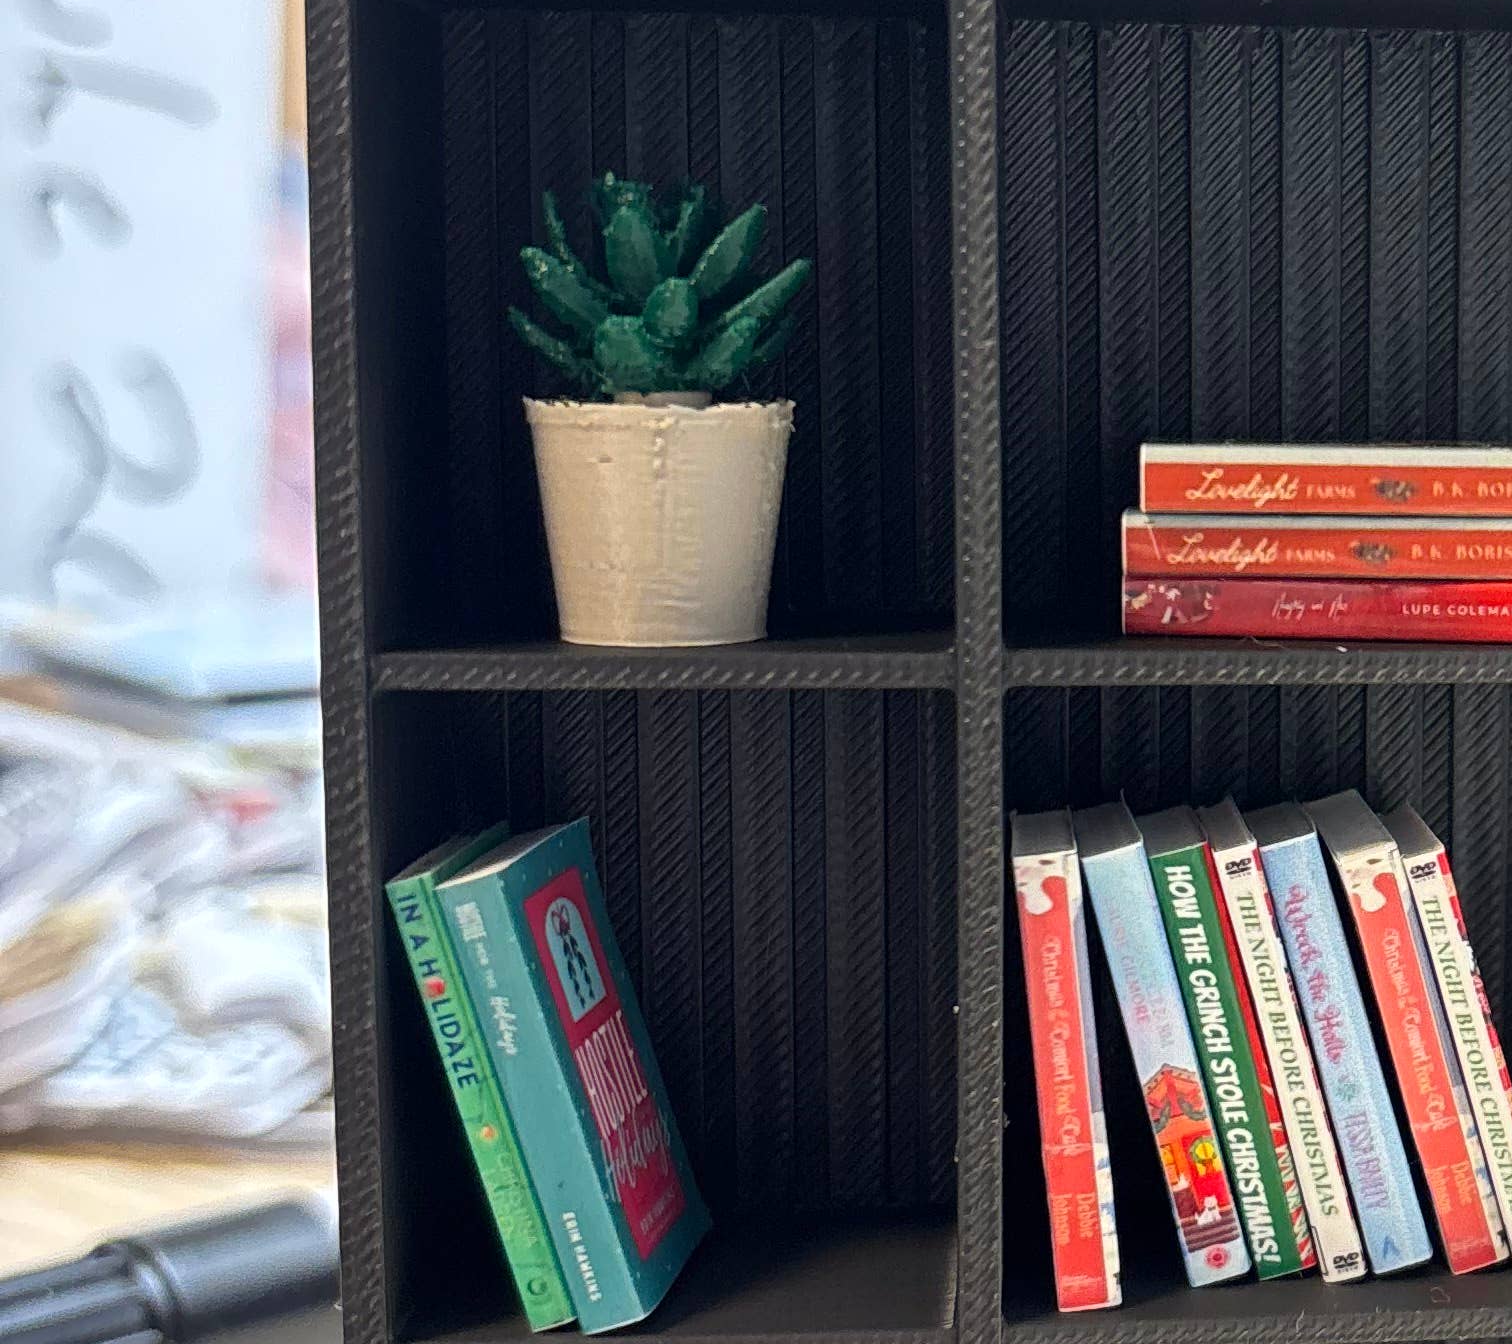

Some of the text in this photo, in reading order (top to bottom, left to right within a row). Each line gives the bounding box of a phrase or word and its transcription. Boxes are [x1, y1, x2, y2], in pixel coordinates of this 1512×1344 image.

[1185, 468, 1299, 508] Lovelight
[1167, 532, 1279, 572] Lovelight
[1401, 604, 1441, 617] LUPE
[398, 893, 422, 922] IN
[410, 931, 432, 950] A
[1422, 894, 1447, 935] THE
[1435, 939, 1467, 1006] NIGHT
[1456, 1012, 1492, 1091] BEFORE
[1167, 864, 1279, 1265] HOW THE GRINCH STOLE CHRISTMAS!
[1235, 891, 1261, 930] THE
[1249, 934, 1281, 1002] NIGHT
[1269, 1009, 1306, 1090] BEFORE
[1293, 1094, 1341, 1216] CHRISTMAS
